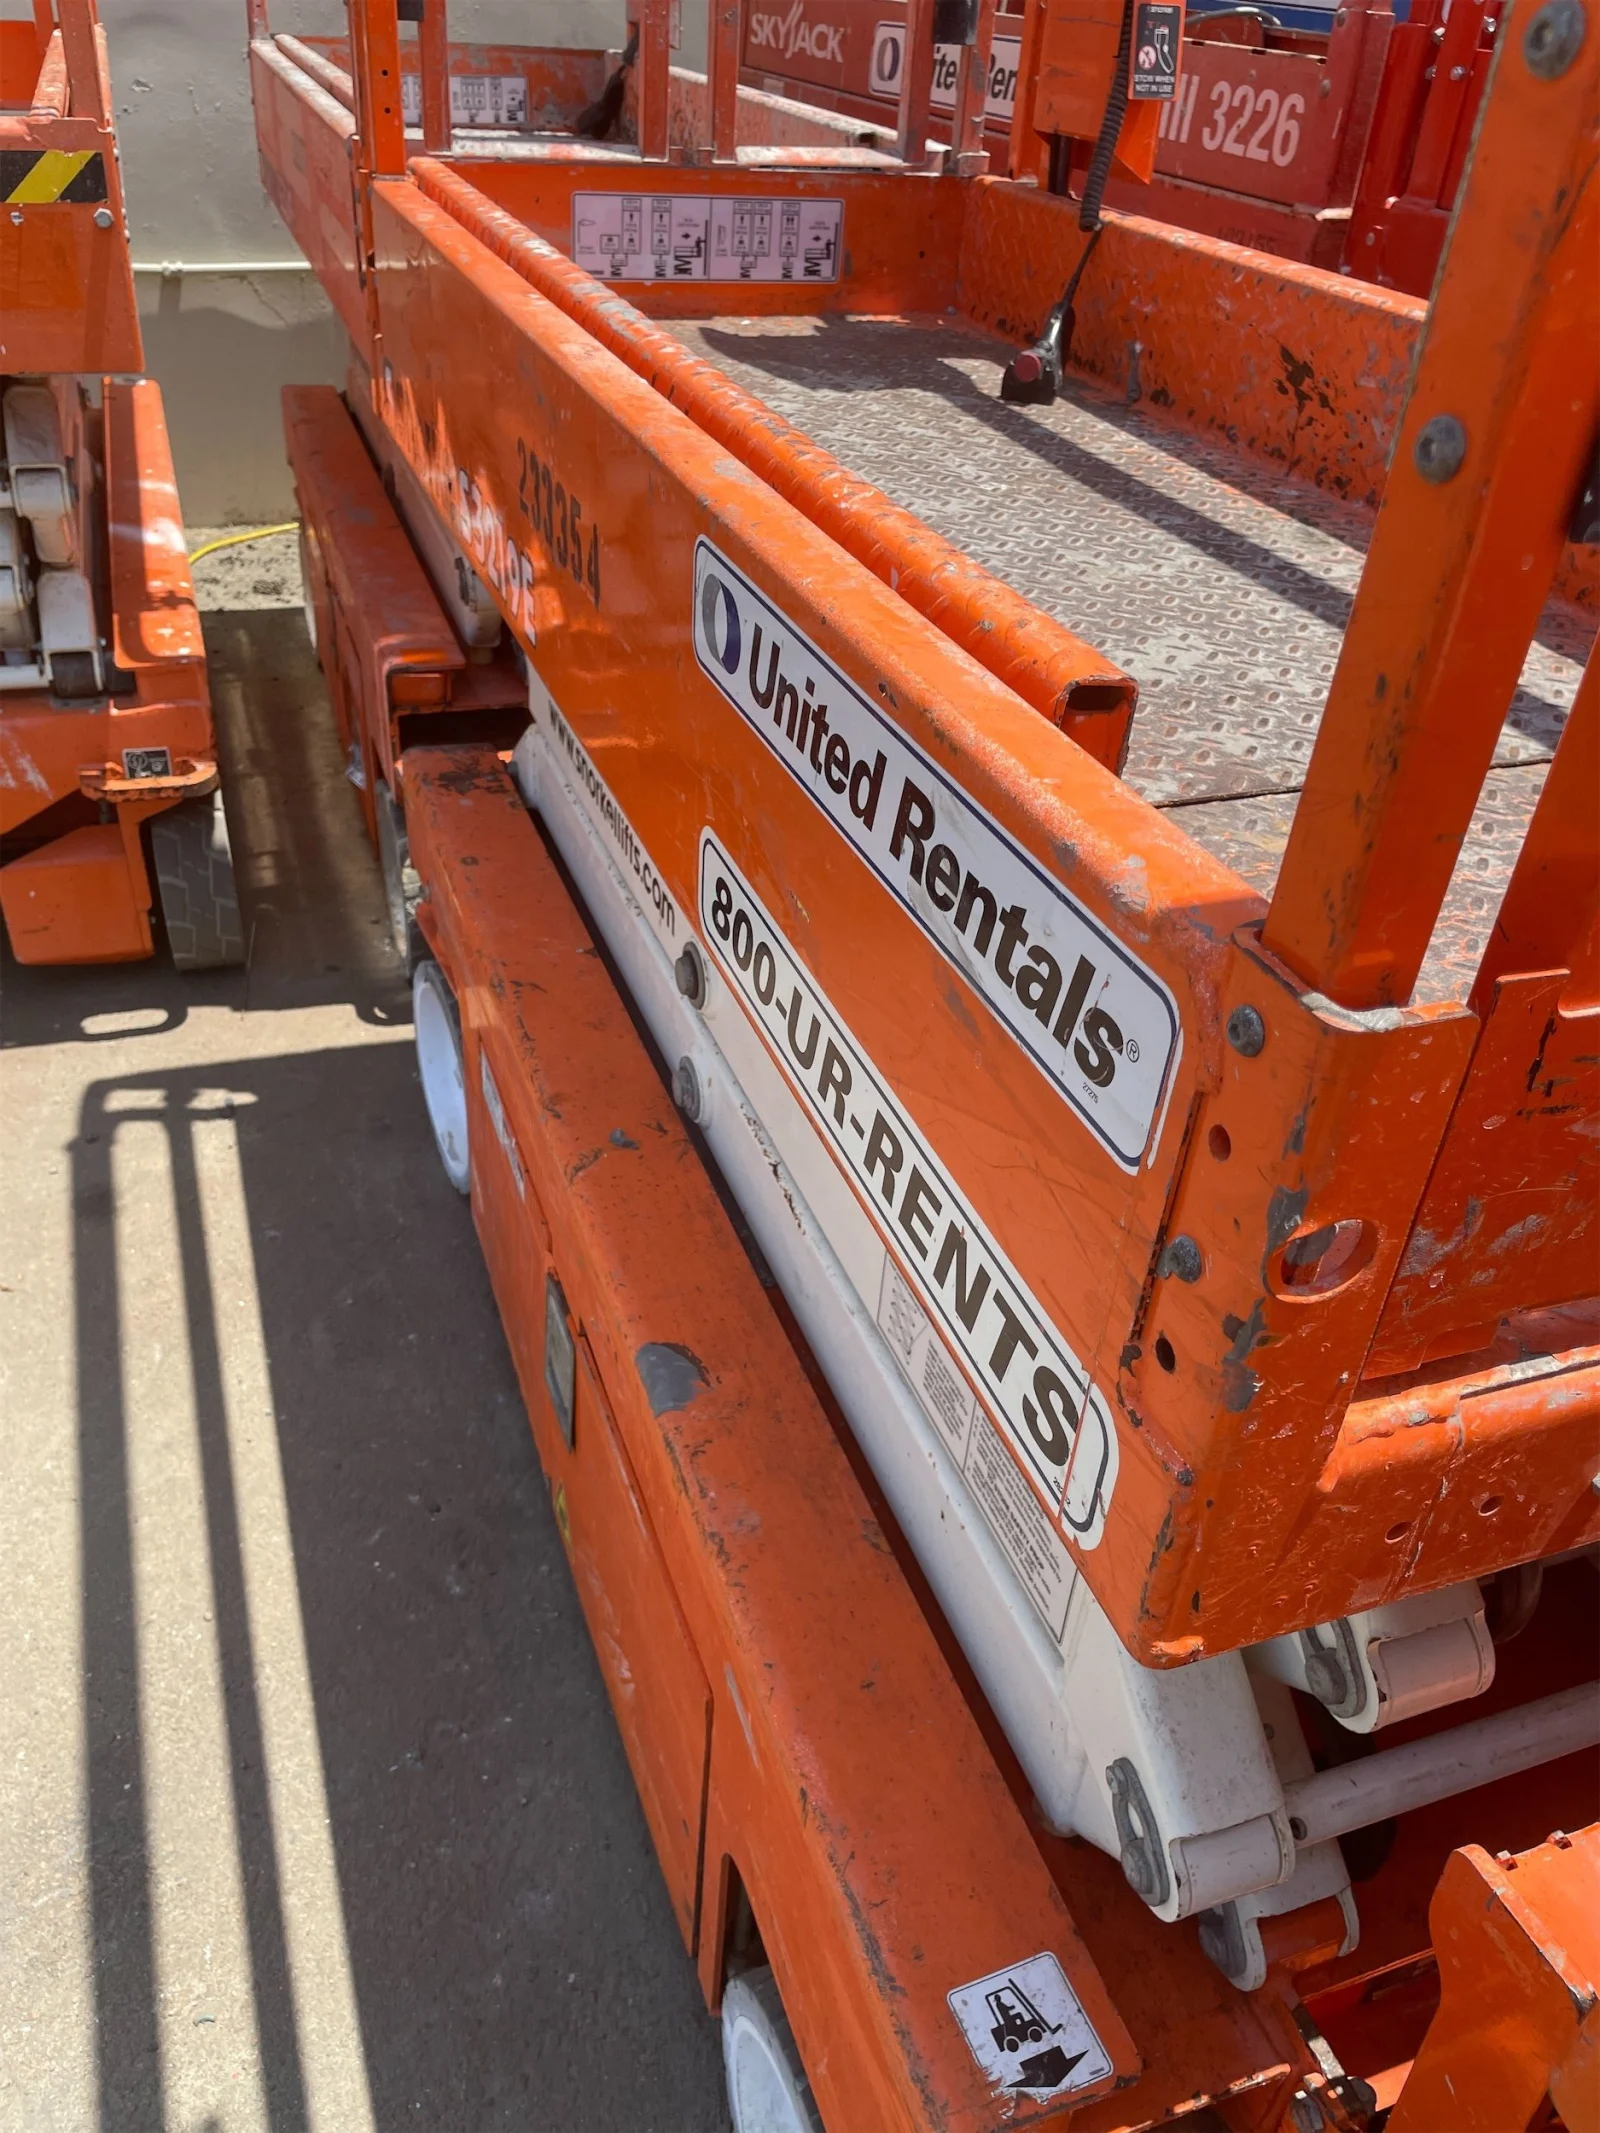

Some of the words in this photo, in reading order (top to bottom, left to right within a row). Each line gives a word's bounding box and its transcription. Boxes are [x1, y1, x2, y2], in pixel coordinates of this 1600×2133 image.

[750, 0, 844, 63] SKYJACK
[1202, 80, 1306, 167] 3226
[548, 698, 676, 936] www.snorkellifts.com
[749, 623, 887, 833] United
[711, 876, 1080, 1467] 800-UR-RENTS
